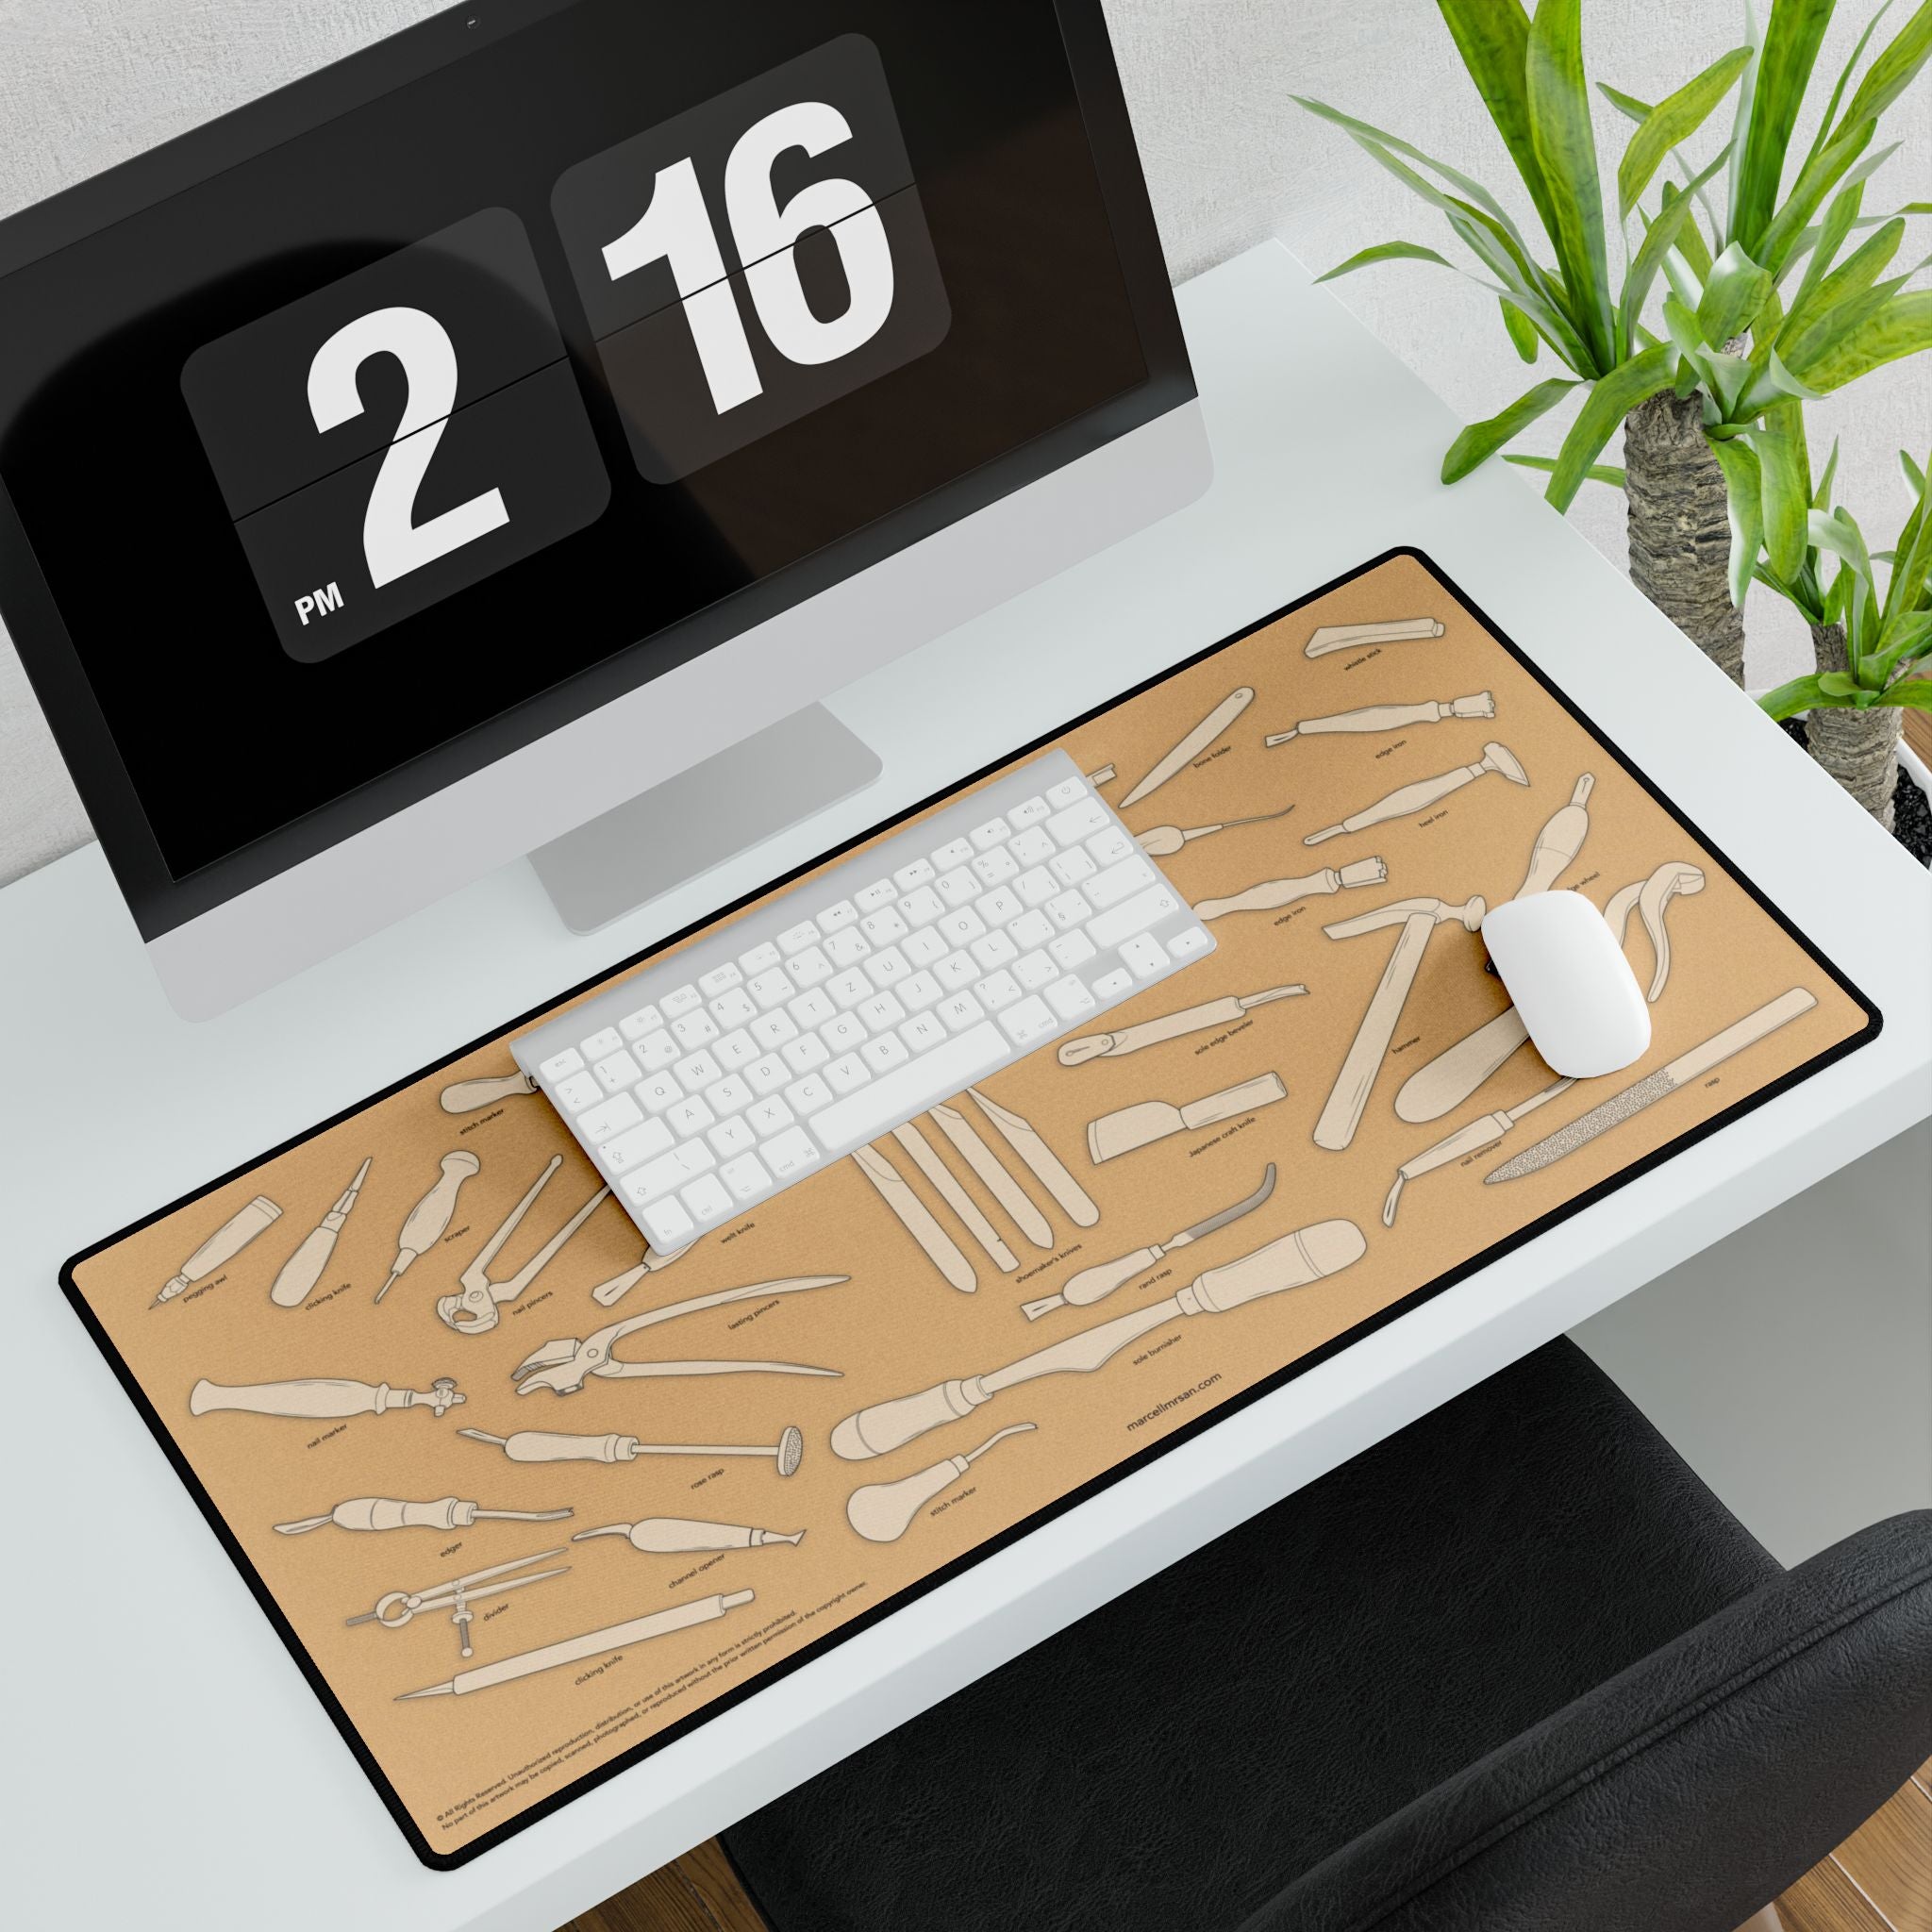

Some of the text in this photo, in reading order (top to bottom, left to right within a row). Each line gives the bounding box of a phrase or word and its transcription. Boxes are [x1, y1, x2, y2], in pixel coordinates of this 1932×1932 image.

[601, 101, 894, 415] 16
[308, 307, 510, 589] 2
[294, 582, 344, 626] PM
[1343, 648, 1383, 672] whistle stick
[1374, 740, 1407, 759] edge iron
[1192, 745, 1232, 769] bone folder
[1418, 809, 1449, 828] heel iron
[1579, 871, 1601, 886] wheel
[941, 880, 949, 889] 0
[904, 901, 911, 909] 9
[995, 901, 1003, 910] P
[1274, 906, 1307, 926] edge iron
[866, 921, 874, 929] 8
[958, 921, 968, 930] O
[828, 941, 835, 950] 7
[988, 943, 997, 952] L
[792, 961, 799, 970] 6
[882, 960, 893, 972] U
[950, 961, 960, 972] K
[754, 981, 761, 991] 5
[845, 981, 856, 992] Z
[915, 983, 922, 992] J
[717, 1002, 724, 1010] 4
[808, 1003, 816, 1011] T
[874, 1003, 885, 1013] H
[954, 1003, 966, 1014] M
[677, 1024, 686, 1032] 3
[770, 1024, 779, 1033] R
[837, 1024, 847, 1034] G
[916, 1024, 928, 1034] N
[1194, 1019, 1254, 1056] sole edge beveler
[639, 1044, 647, 1054] 2
[731, 1044, 741, 1055] E
[799, 1045, 807, 1055] F
[878, 1045, 889, 1055] B
[1391, 1036, 1422, 1055] hammer
[691, 1064, 704, 1075] W
[759, 1066, 771, 1076] D
[840, 1065, 849, 1075] V
[1704, 1077, 1721, 1089] rasp
[655, 1087, 665, 1095] Q
[723, 1088, 732, 1097] S
[803, 1087, 813, 1096] C
[685, 1108, 694, 1119] A
[764, 1108, 774, 1118] X
[459, 1108, 505, 1136] stitch marker
[724, 1128, 734, 1139] Y
[1189, 1117, 1257, 1158] Japanese craft knife
[1460, 1140, 1503, 1168] nail remover
[443, 1225, 471, 1242] scraper
[720, 1223, 756, 1244] welt knife
[1015, 1243, 1083, 1284] shoemaker's knives
[1138, 1268, 1173, 1291] rand rasp
[182, 1274, 228, 1304] pegging awl
[305, 1283, 352, 1311] clicking knife
[512, 1291, 554, 1317] nail pincers
[727, 1299, 781, 1331] lasting pincers
[1132, 1334, 1182, 1366] sole burnisher
[1126, 1373, 1223, 1432] marcellmrsan.com
[307, 1424, 348, 1450] nail marker
[691, 1468, 725, 1491] rose rasp
[929, 1486, 977, 1517] stitch marker
[440, 1541, 463, 1558] edger
[668, 1553, 725, 1590] channel opener
[483, 1603, 509, 1622] divider
[575, 1655, 624, 1686] clicking knife
